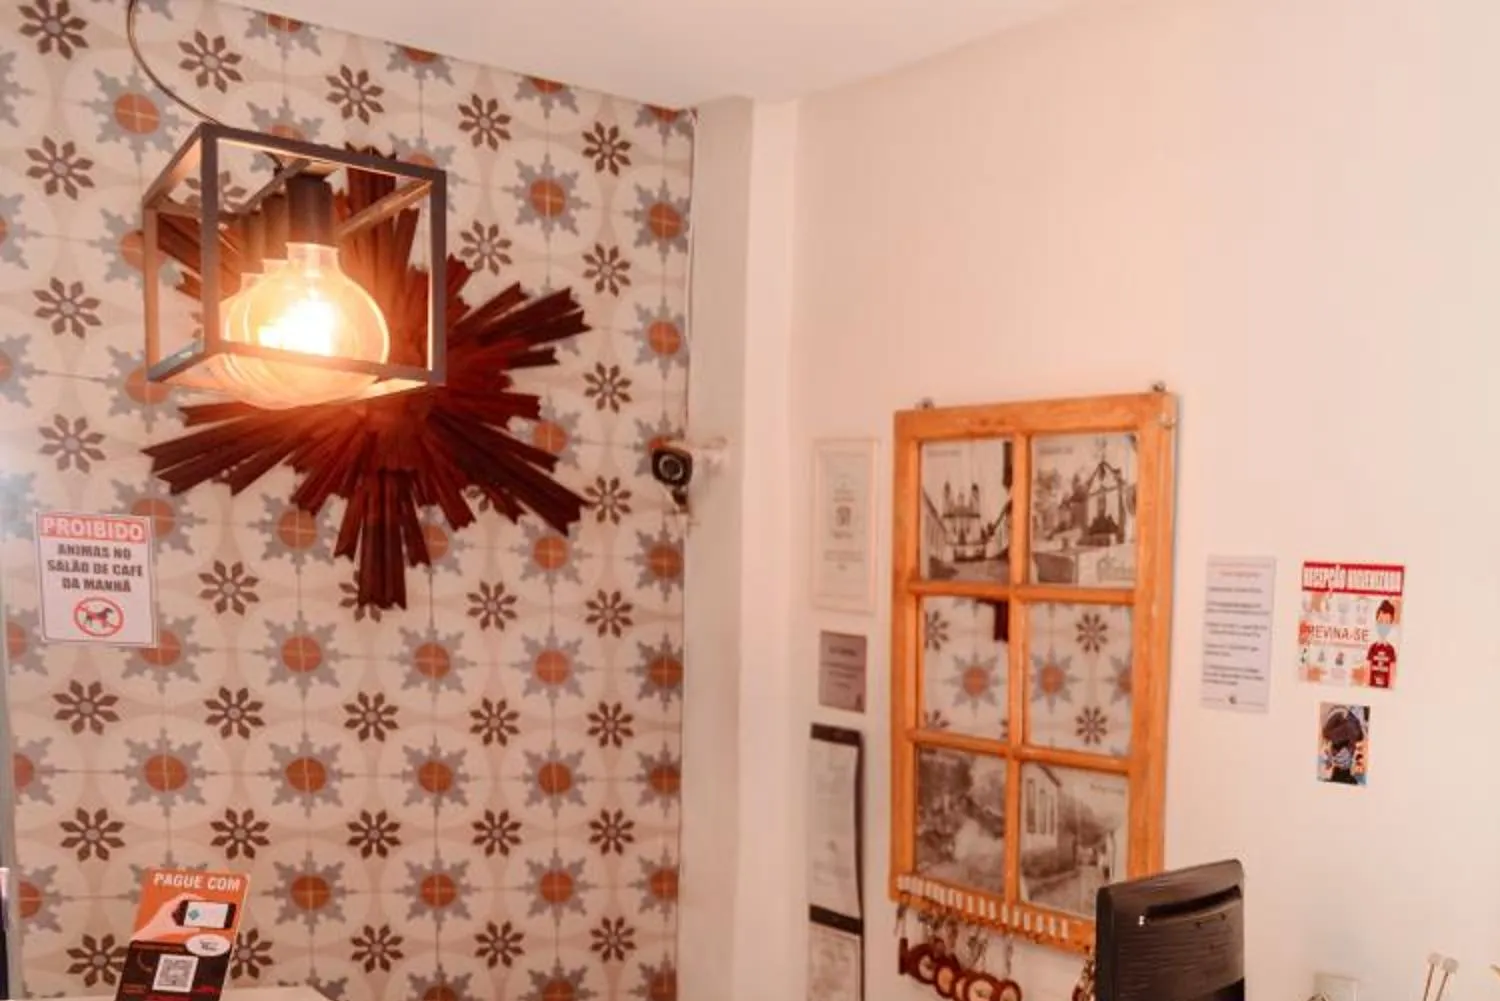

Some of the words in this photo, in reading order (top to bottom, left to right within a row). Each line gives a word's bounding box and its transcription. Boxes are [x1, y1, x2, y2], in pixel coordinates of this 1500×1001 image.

[42, 517, 144, 541] PROIBIDO
[113, 546, 132, 560] NO
[47, 559, 90, 573] SALÃO
[93, 563, 109, 575] DE
[62, 577, 81, 590] DA
[153, 872, 204, 889] PAGUE
[207, 876, 241, 891] COM
